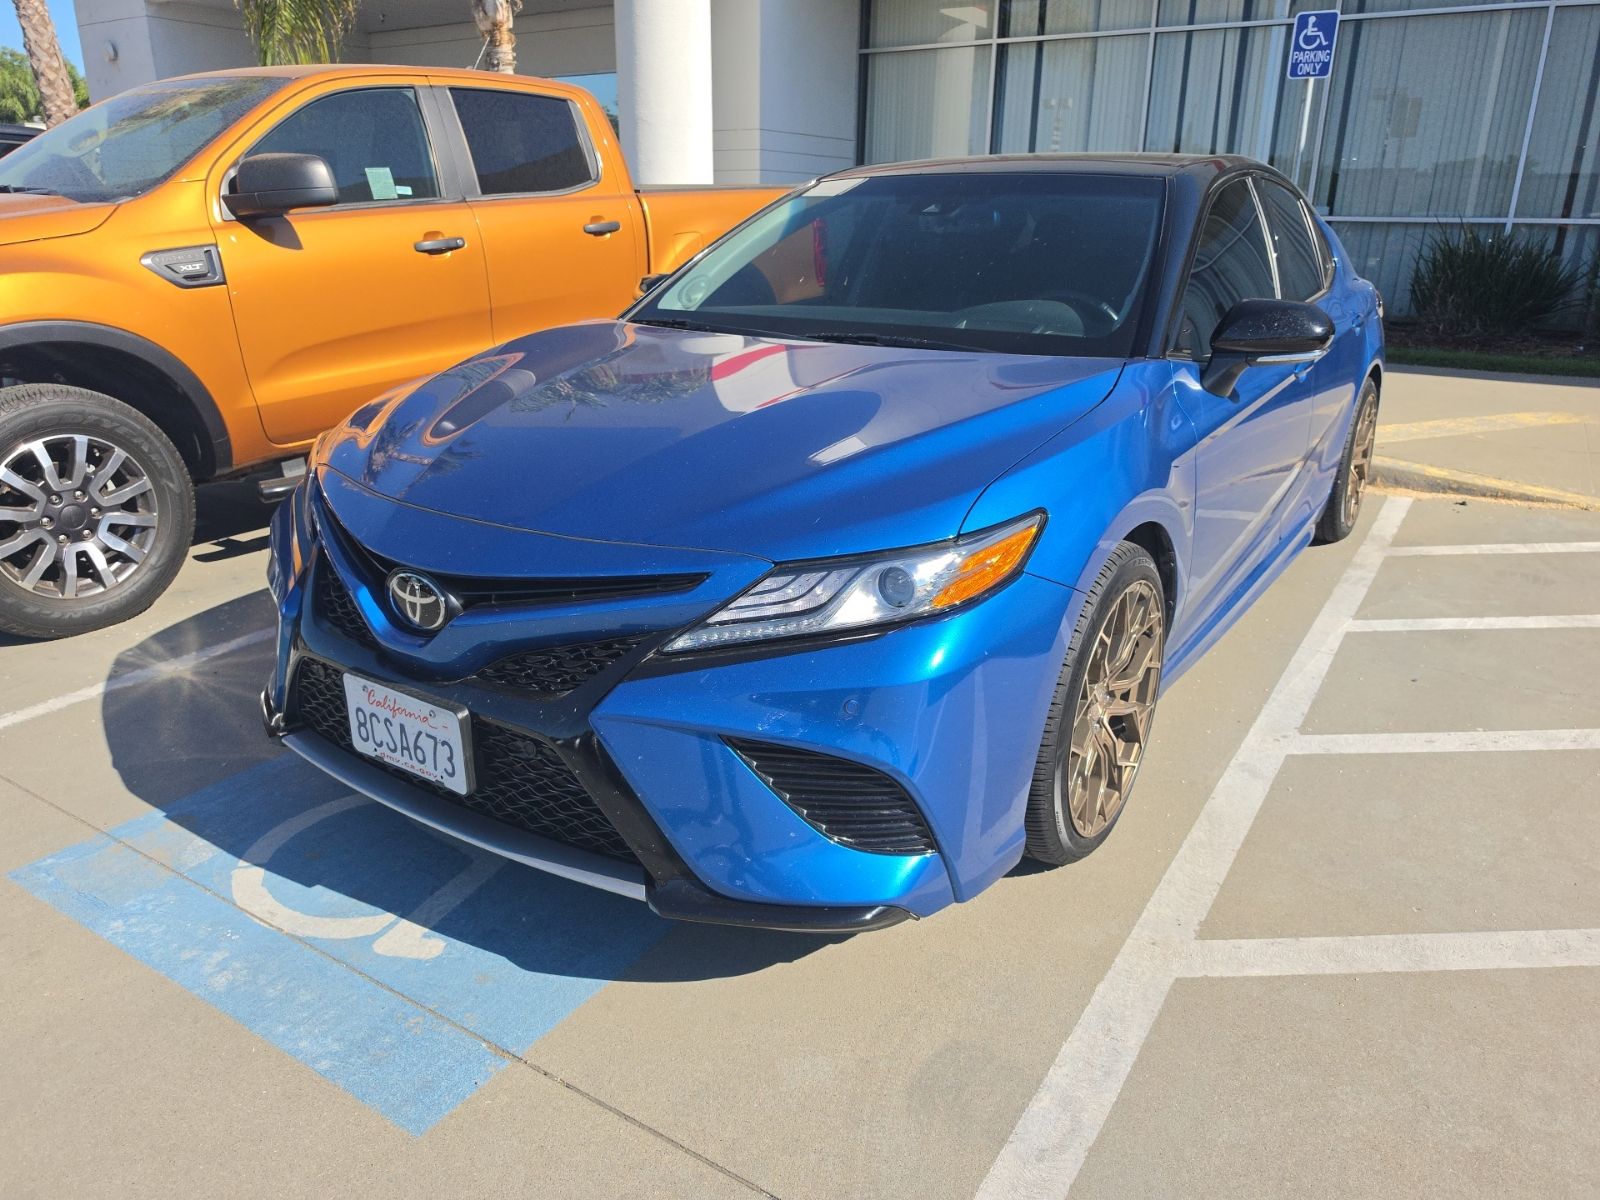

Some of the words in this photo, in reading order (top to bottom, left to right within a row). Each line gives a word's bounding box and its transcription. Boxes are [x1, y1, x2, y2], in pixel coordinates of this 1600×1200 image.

[1292, 50, 1331, 63] PARKING
[1297, 62, 1322, 76] ONLY
[180, 263, 203, 272] XLT
[367, 689, 438, 729] California
[355, 707, 456, 778] 8CSA673
